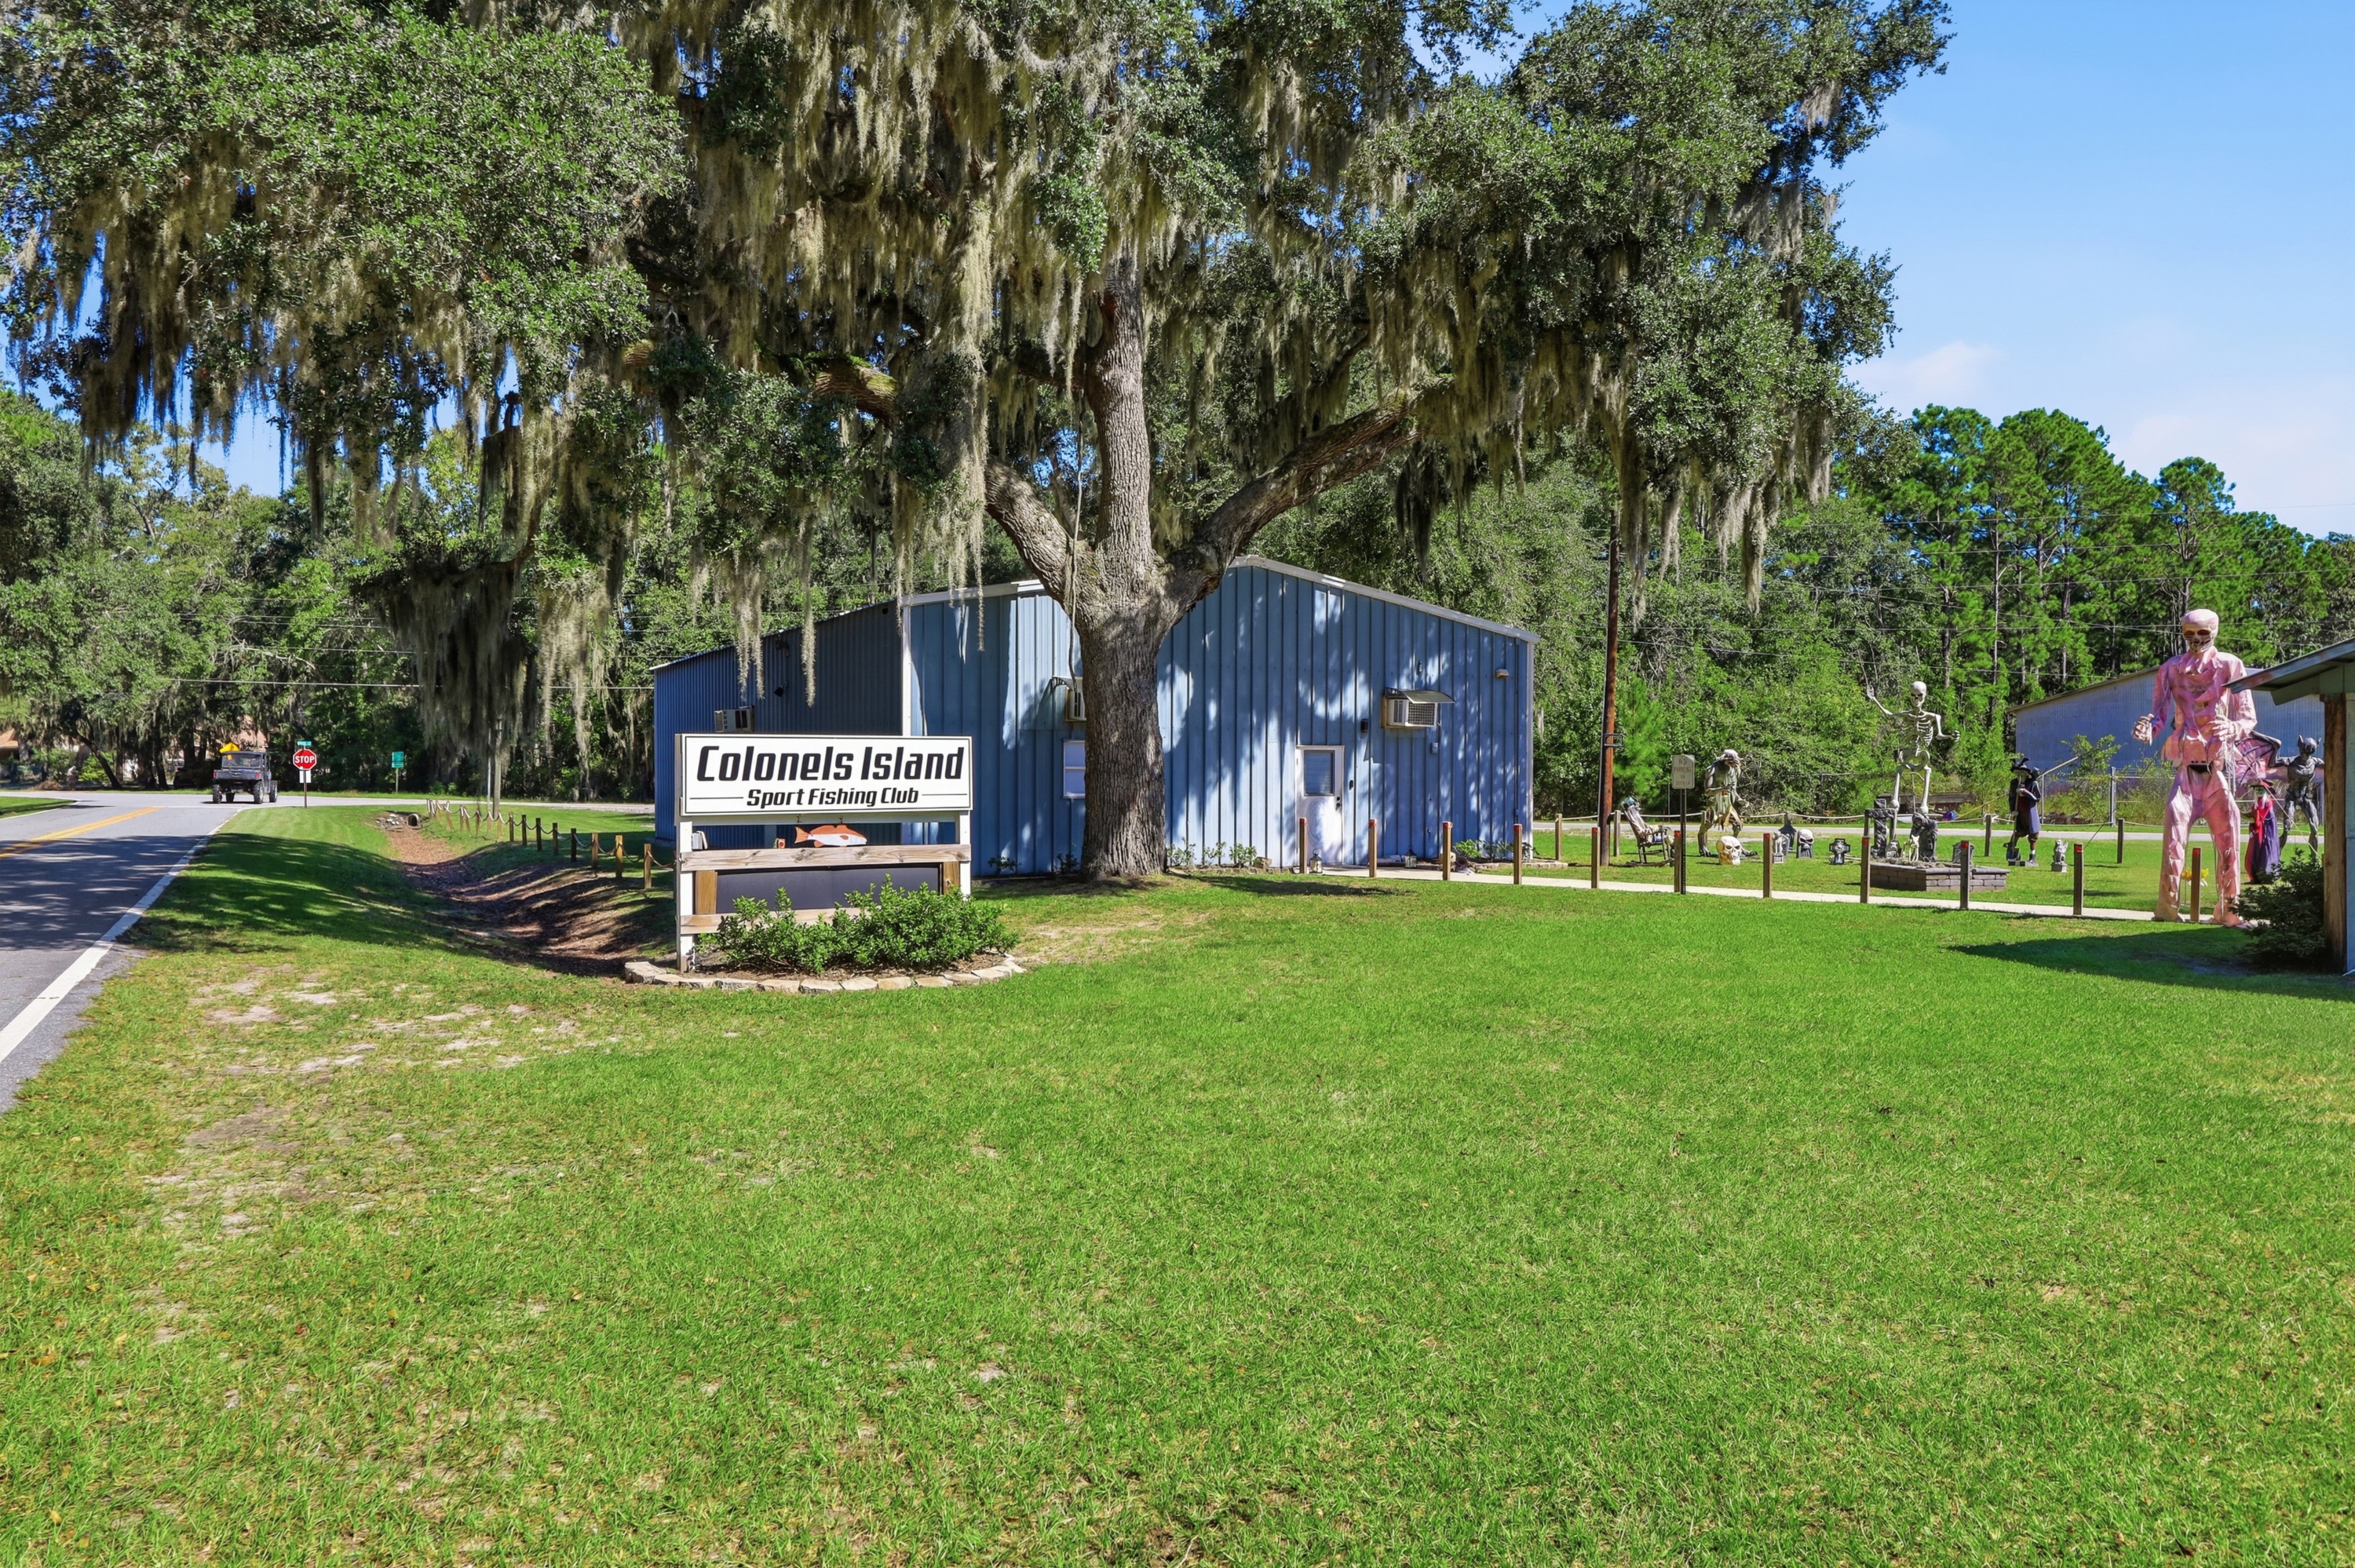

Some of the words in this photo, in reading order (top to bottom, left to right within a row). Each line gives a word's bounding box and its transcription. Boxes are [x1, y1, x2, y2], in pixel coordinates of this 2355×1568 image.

[294, 755, 315, 764] STOP
[696, 746, 854, 782] Colonels
[860, 746, 965, 780] Island
[747, 789, 805, 809] Sport
[808, 787, 878, 808] Fishing
[880, 787, 919, 804] Club
